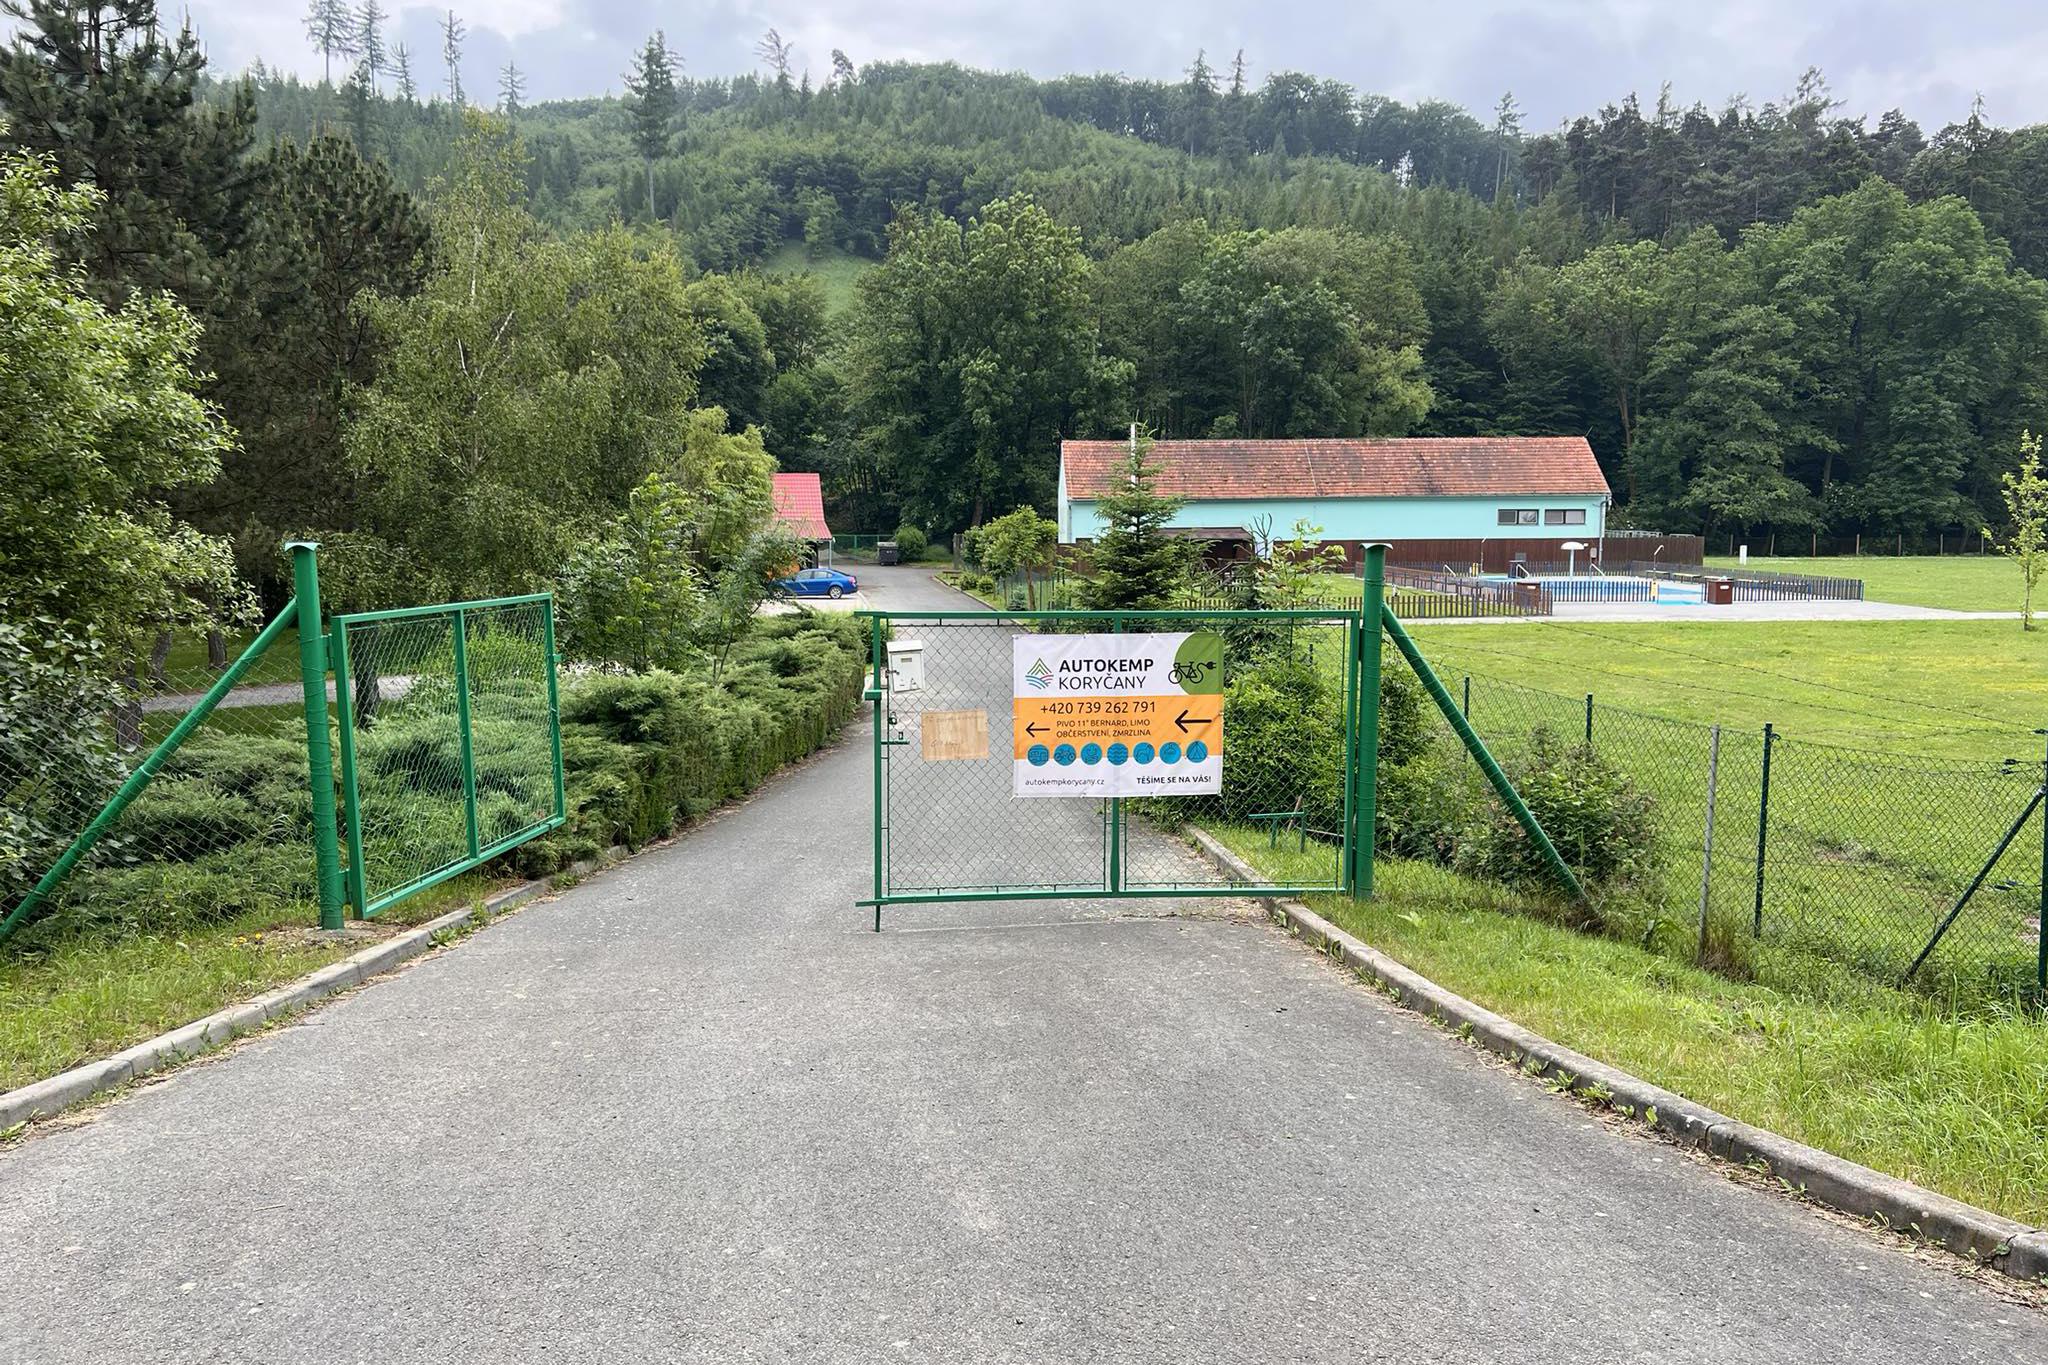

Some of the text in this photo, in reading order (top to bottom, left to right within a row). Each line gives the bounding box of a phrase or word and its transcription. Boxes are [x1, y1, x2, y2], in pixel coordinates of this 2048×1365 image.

[1059, 658, 1154, 672] AUTOKEMP
[1059, 673, 1147, 690] KORYČANY
[1040, 701, 1156, 715] +420 739 262 791
[1091, 719, 1129, 727] BERNARD,
[1056, 729, 1151, 738] OBČERSTVENÍ, ZMRZLINA
[1025, 778, 1105, 787] autokempkorycany.cz
[1136, 776, 1165, 784] TĚŠÍME
[1167, 776, 1177, 784] SE
[1192, 775, 1212, 783] VÁS!
